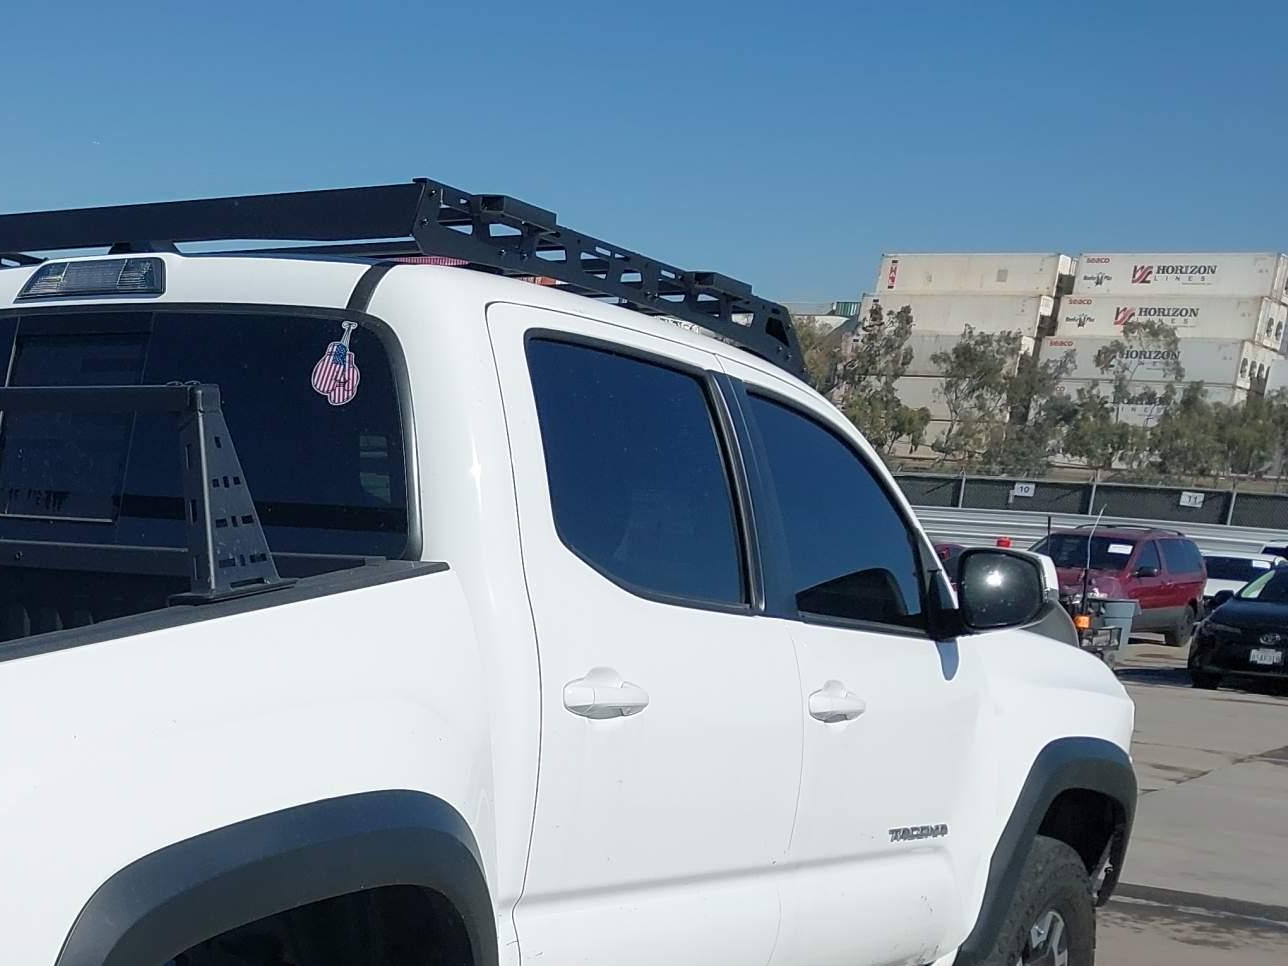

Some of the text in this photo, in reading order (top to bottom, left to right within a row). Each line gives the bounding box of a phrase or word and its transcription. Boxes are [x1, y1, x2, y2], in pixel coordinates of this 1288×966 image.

[1155, 265, 1217, 275] HORIZON
[1138, 307, 1200, 317] HORIZON
[1121, 350, 1181, 360] HORIZON
[888, 823, 950, 843] TACOMA
